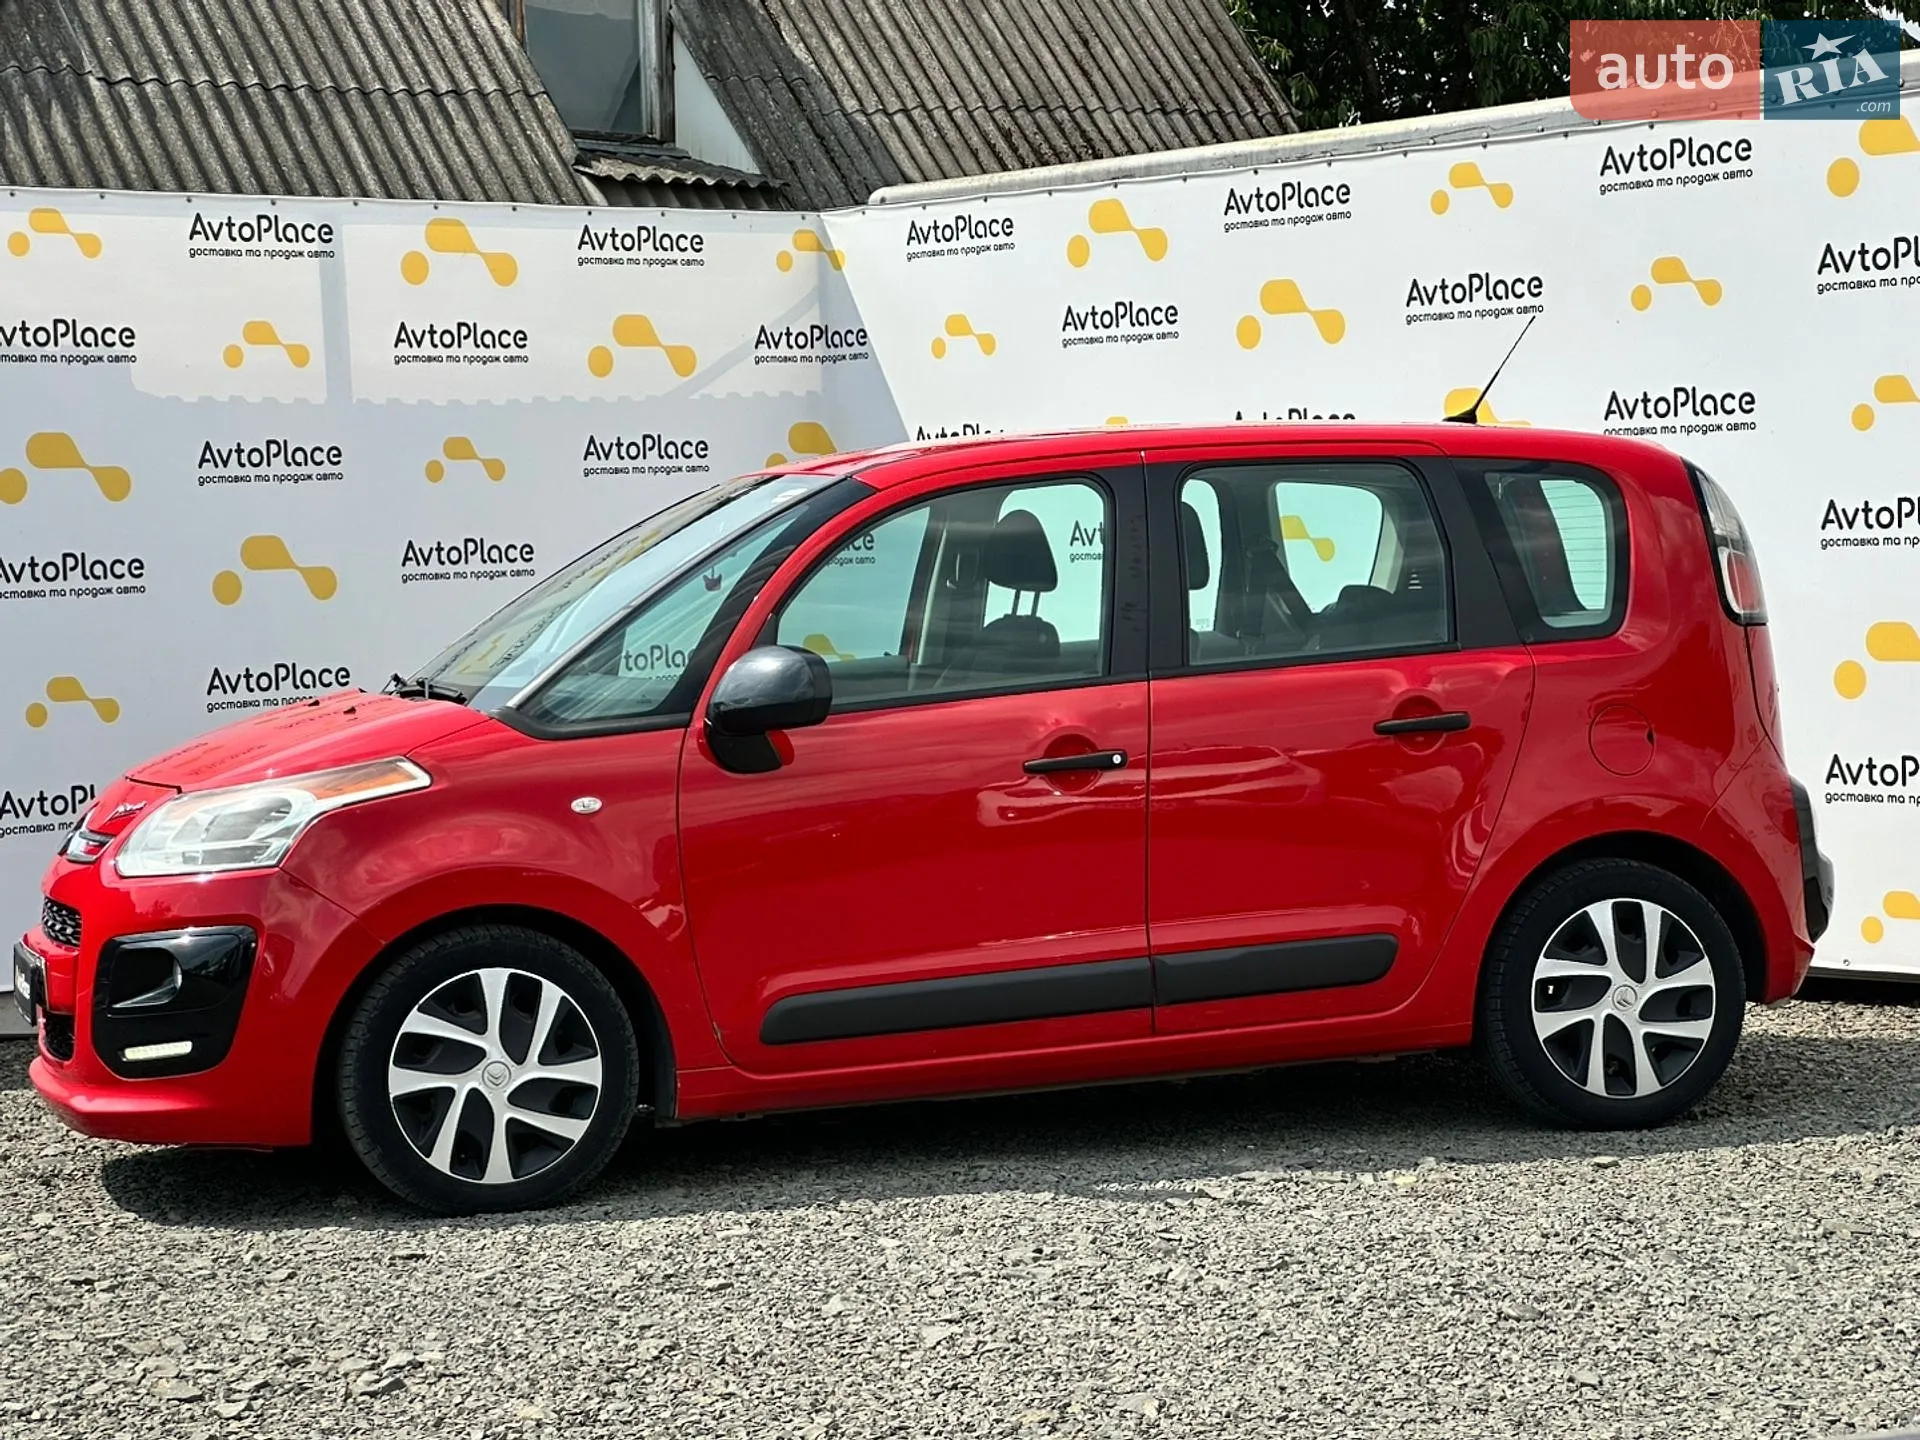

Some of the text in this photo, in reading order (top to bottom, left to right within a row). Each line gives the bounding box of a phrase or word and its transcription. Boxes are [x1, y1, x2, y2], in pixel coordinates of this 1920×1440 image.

[1600, 136, 1753, 176] AvtoPlace
[1224, 181, 1351, 216] AvtoPlace
[188, 212, 335, 244] AvtoPlace
[577, 224, 705, 253] AvtoPlace
[907, 214, 1015, 246] AvtoPlace
[1817, 235, 1920, 275] AvtoPl
[1406, 272, 1544, 307] AvtoPlace
[1061, 301, 1179, 332] AvtoPlace
[0, 318, 136, 348] vtoPlace
[394, 321, 529, 350] AvtoPlace
[754, 324, 868, 351] AvtoPlace
[0, 353, 38, 363] тавка
[1603, 386, 1756, 422] AvtoPlace
[198, 439, 343, 469] AvtoPlace
[583, 433, 709, 462] AvtoPlace
[1820, 495, 1920, 531] AvtoP
[402, 537, 535, 567] AvtoPlace
[0, 588, 47, 600] ставка
[624, 644, 687, 672] toPla
[207, 662, 351, 696] AvtoPlace
[1825, 753, 1920, 787] AvtoP
[0, 784, 96, 820] AvtoPl
